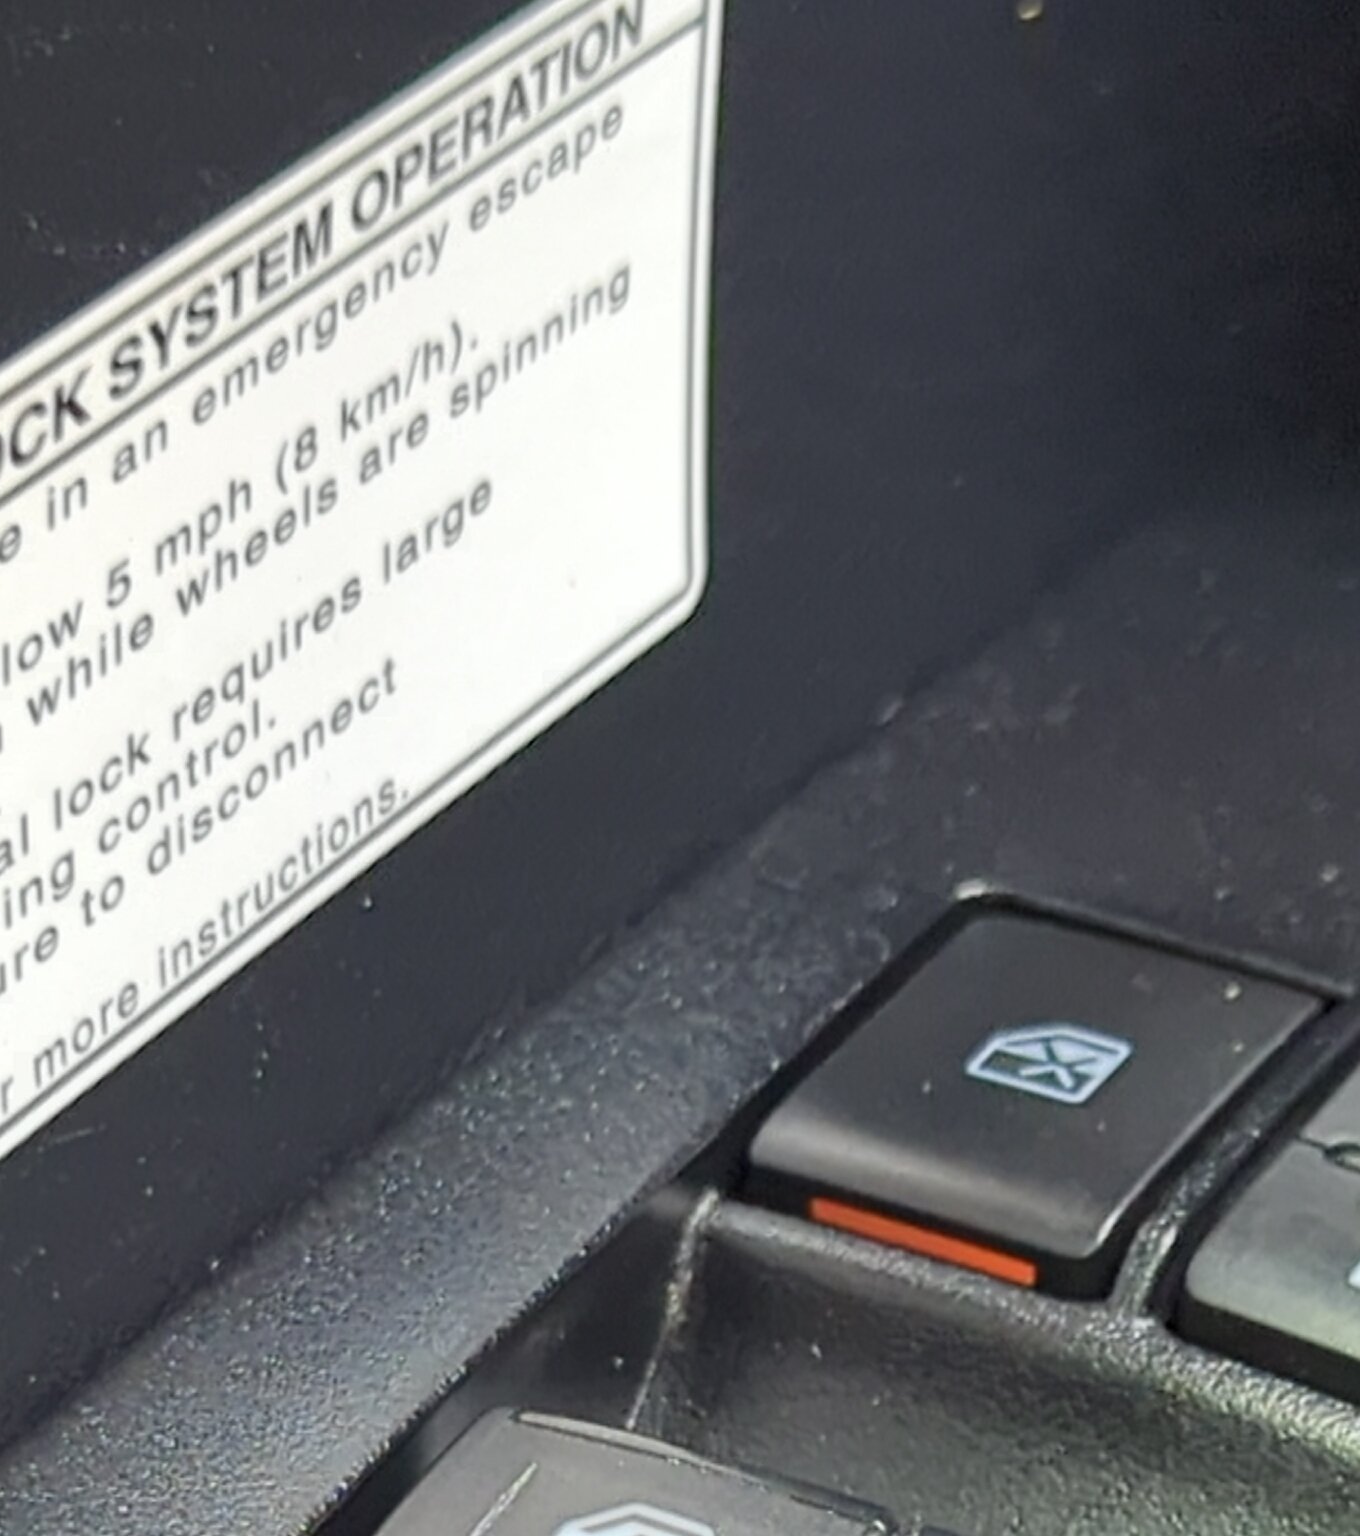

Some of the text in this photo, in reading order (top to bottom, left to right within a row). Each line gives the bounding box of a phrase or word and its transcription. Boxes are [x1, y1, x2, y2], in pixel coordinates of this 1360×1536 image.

[46, 475, 87, 530] in
[111, 418, 168, 484] an
[190, 220, 449, 425] emergency
[468, 102, 622, 232] escape
[109, 201, 334, 400] SYSTEM
[350, 0, 643, 233] OPERATION
[25, 611, 154, 726] while
[174, 476, 338, 616] wheels
[358, 410, 429, 485] are
[449, 264, 629, 418] spinning
[105, 557, 131, 609] 5
[154, 478, 252, 575] mph
[274, 423, 318, 494] (8
[339, 319, 477, 442] km/h).
[53, 732, 151, 830] lock
[171, 575, 362, 742] requires
[382, 478, 492, 584] large
[80, 874, 124, 927] to
[146, 657, 395, 875] disconnect
[97, 697, 275, 854] control.
[32, 981, 138, 1088] more
[158, 778, 407, 988] instructions.
